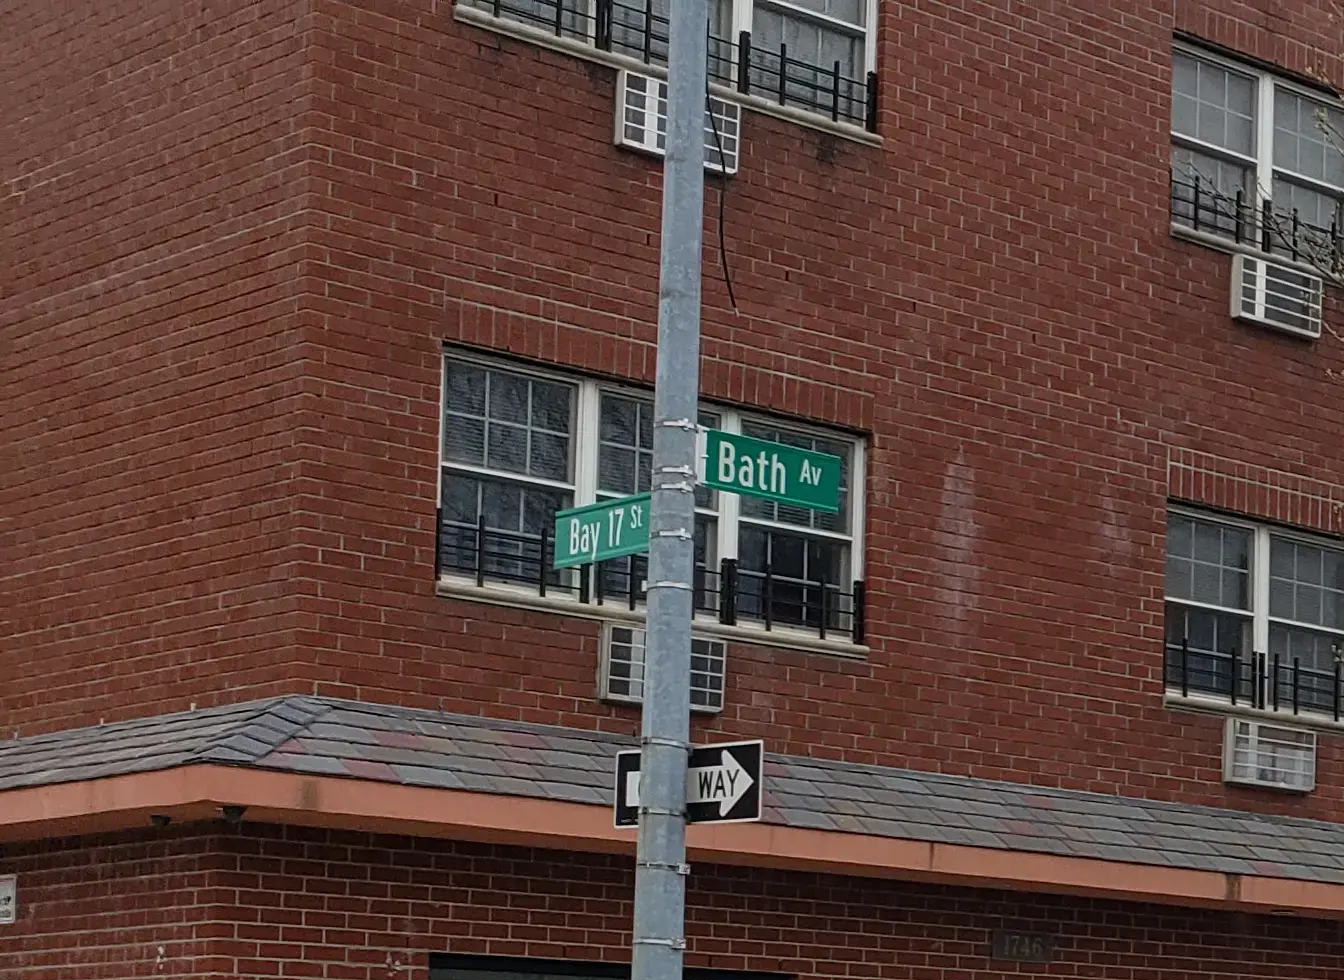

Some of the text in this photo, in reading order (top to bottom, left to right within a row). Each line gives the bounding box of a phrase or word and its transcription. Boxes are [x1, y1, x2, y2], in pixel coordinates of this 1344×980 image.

[718, 440, 822, 494] Bath Av
[569, 505, 643, 560] Bay 17 St
[698, 768, 740, 799] WAY
[1003, 935, 1043, 957] 1746
